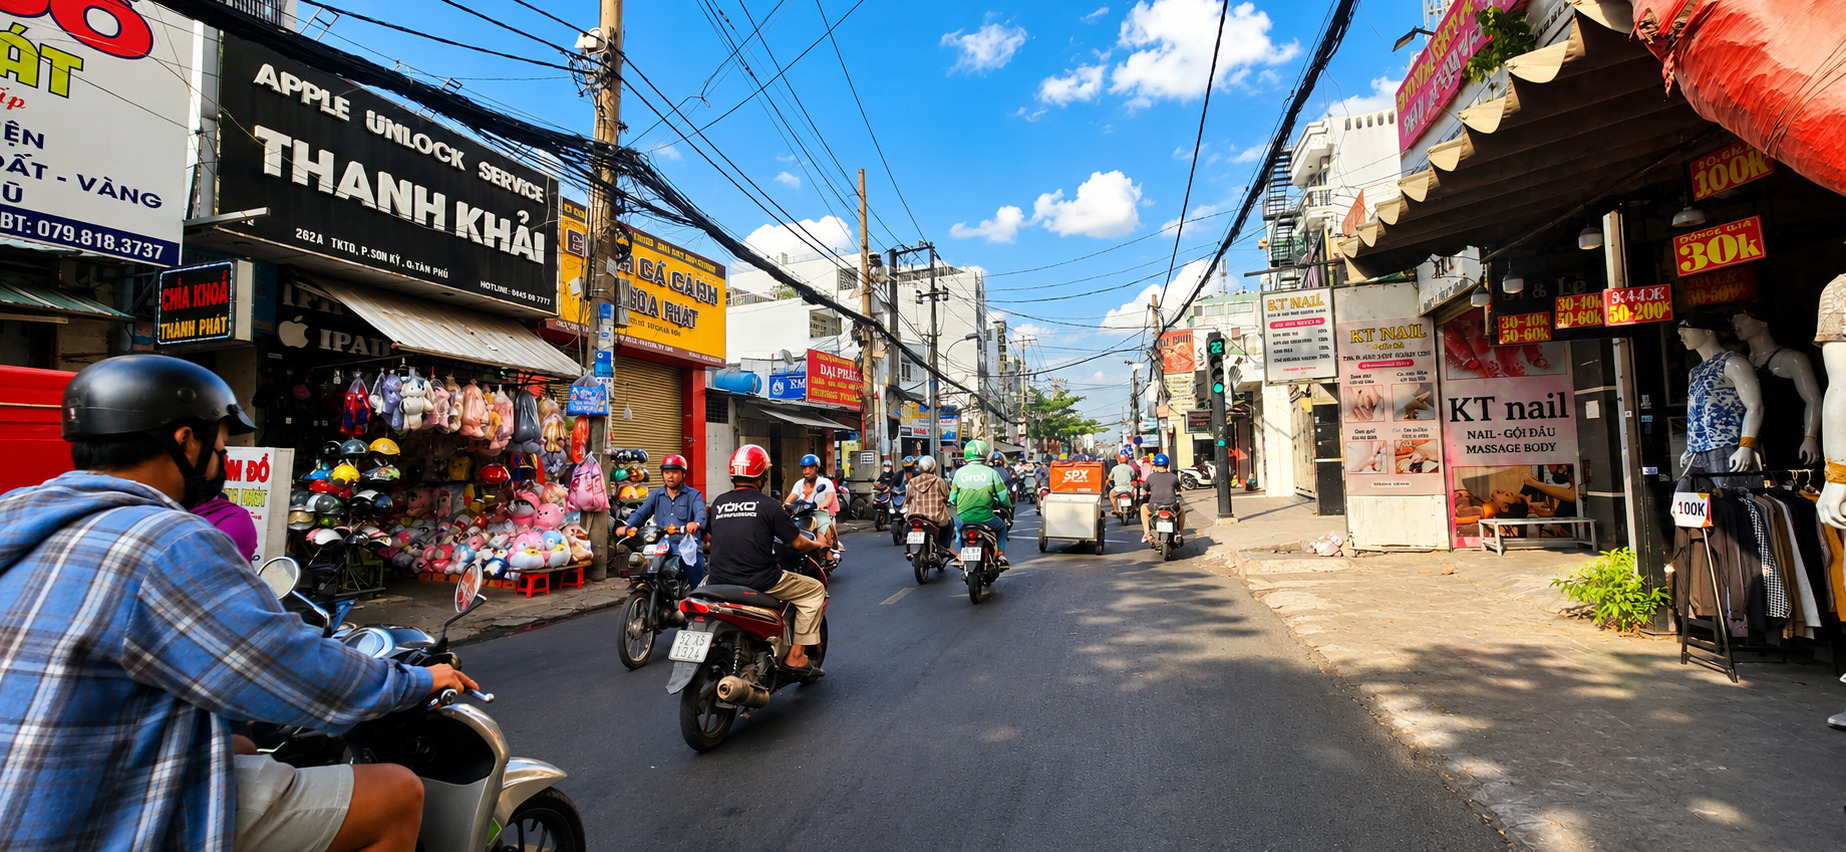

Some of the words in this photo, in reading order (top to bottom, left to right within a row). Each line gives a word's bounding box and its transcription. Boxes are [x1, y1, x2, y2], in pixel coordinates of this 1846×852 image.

[253, 63, 350, 122] APPLE
[366, 110, 465, 171] UNLOCK
[0, 120, 44, 150] ỆN
[77, 174, 162, 209] VÀNG
[254, 124, 447, 231] THANH
[455, 200, 546, 265] KHẢI
[37, 219, 164, 260] 079.818.3737
[295, 227, 323, 245] 262A
[1679, 233, 1761, 272] 30k
[193, 270, 229, 308] KHOÁ
[1290, 293, 1325, 309] NAIL
[199, 313, 228, 336] PHÁT
[1350, 327, 1375, 344] KT
[1380, 323, 1427, 341] NAIL
[319, 328, 391, 357] IPAD
[1448, 396, 1495, 423] KT
[1505, 391, 1569, 421] nail
[1466, 443, 1521, 454] MASSAGE
[1524, 442, 1557, 453] BODY
[1467, 429, 1496, 440] NAIL
[1064, 469, 1089, 480] SPX
[1678, 501, 1705, 517] 100K
